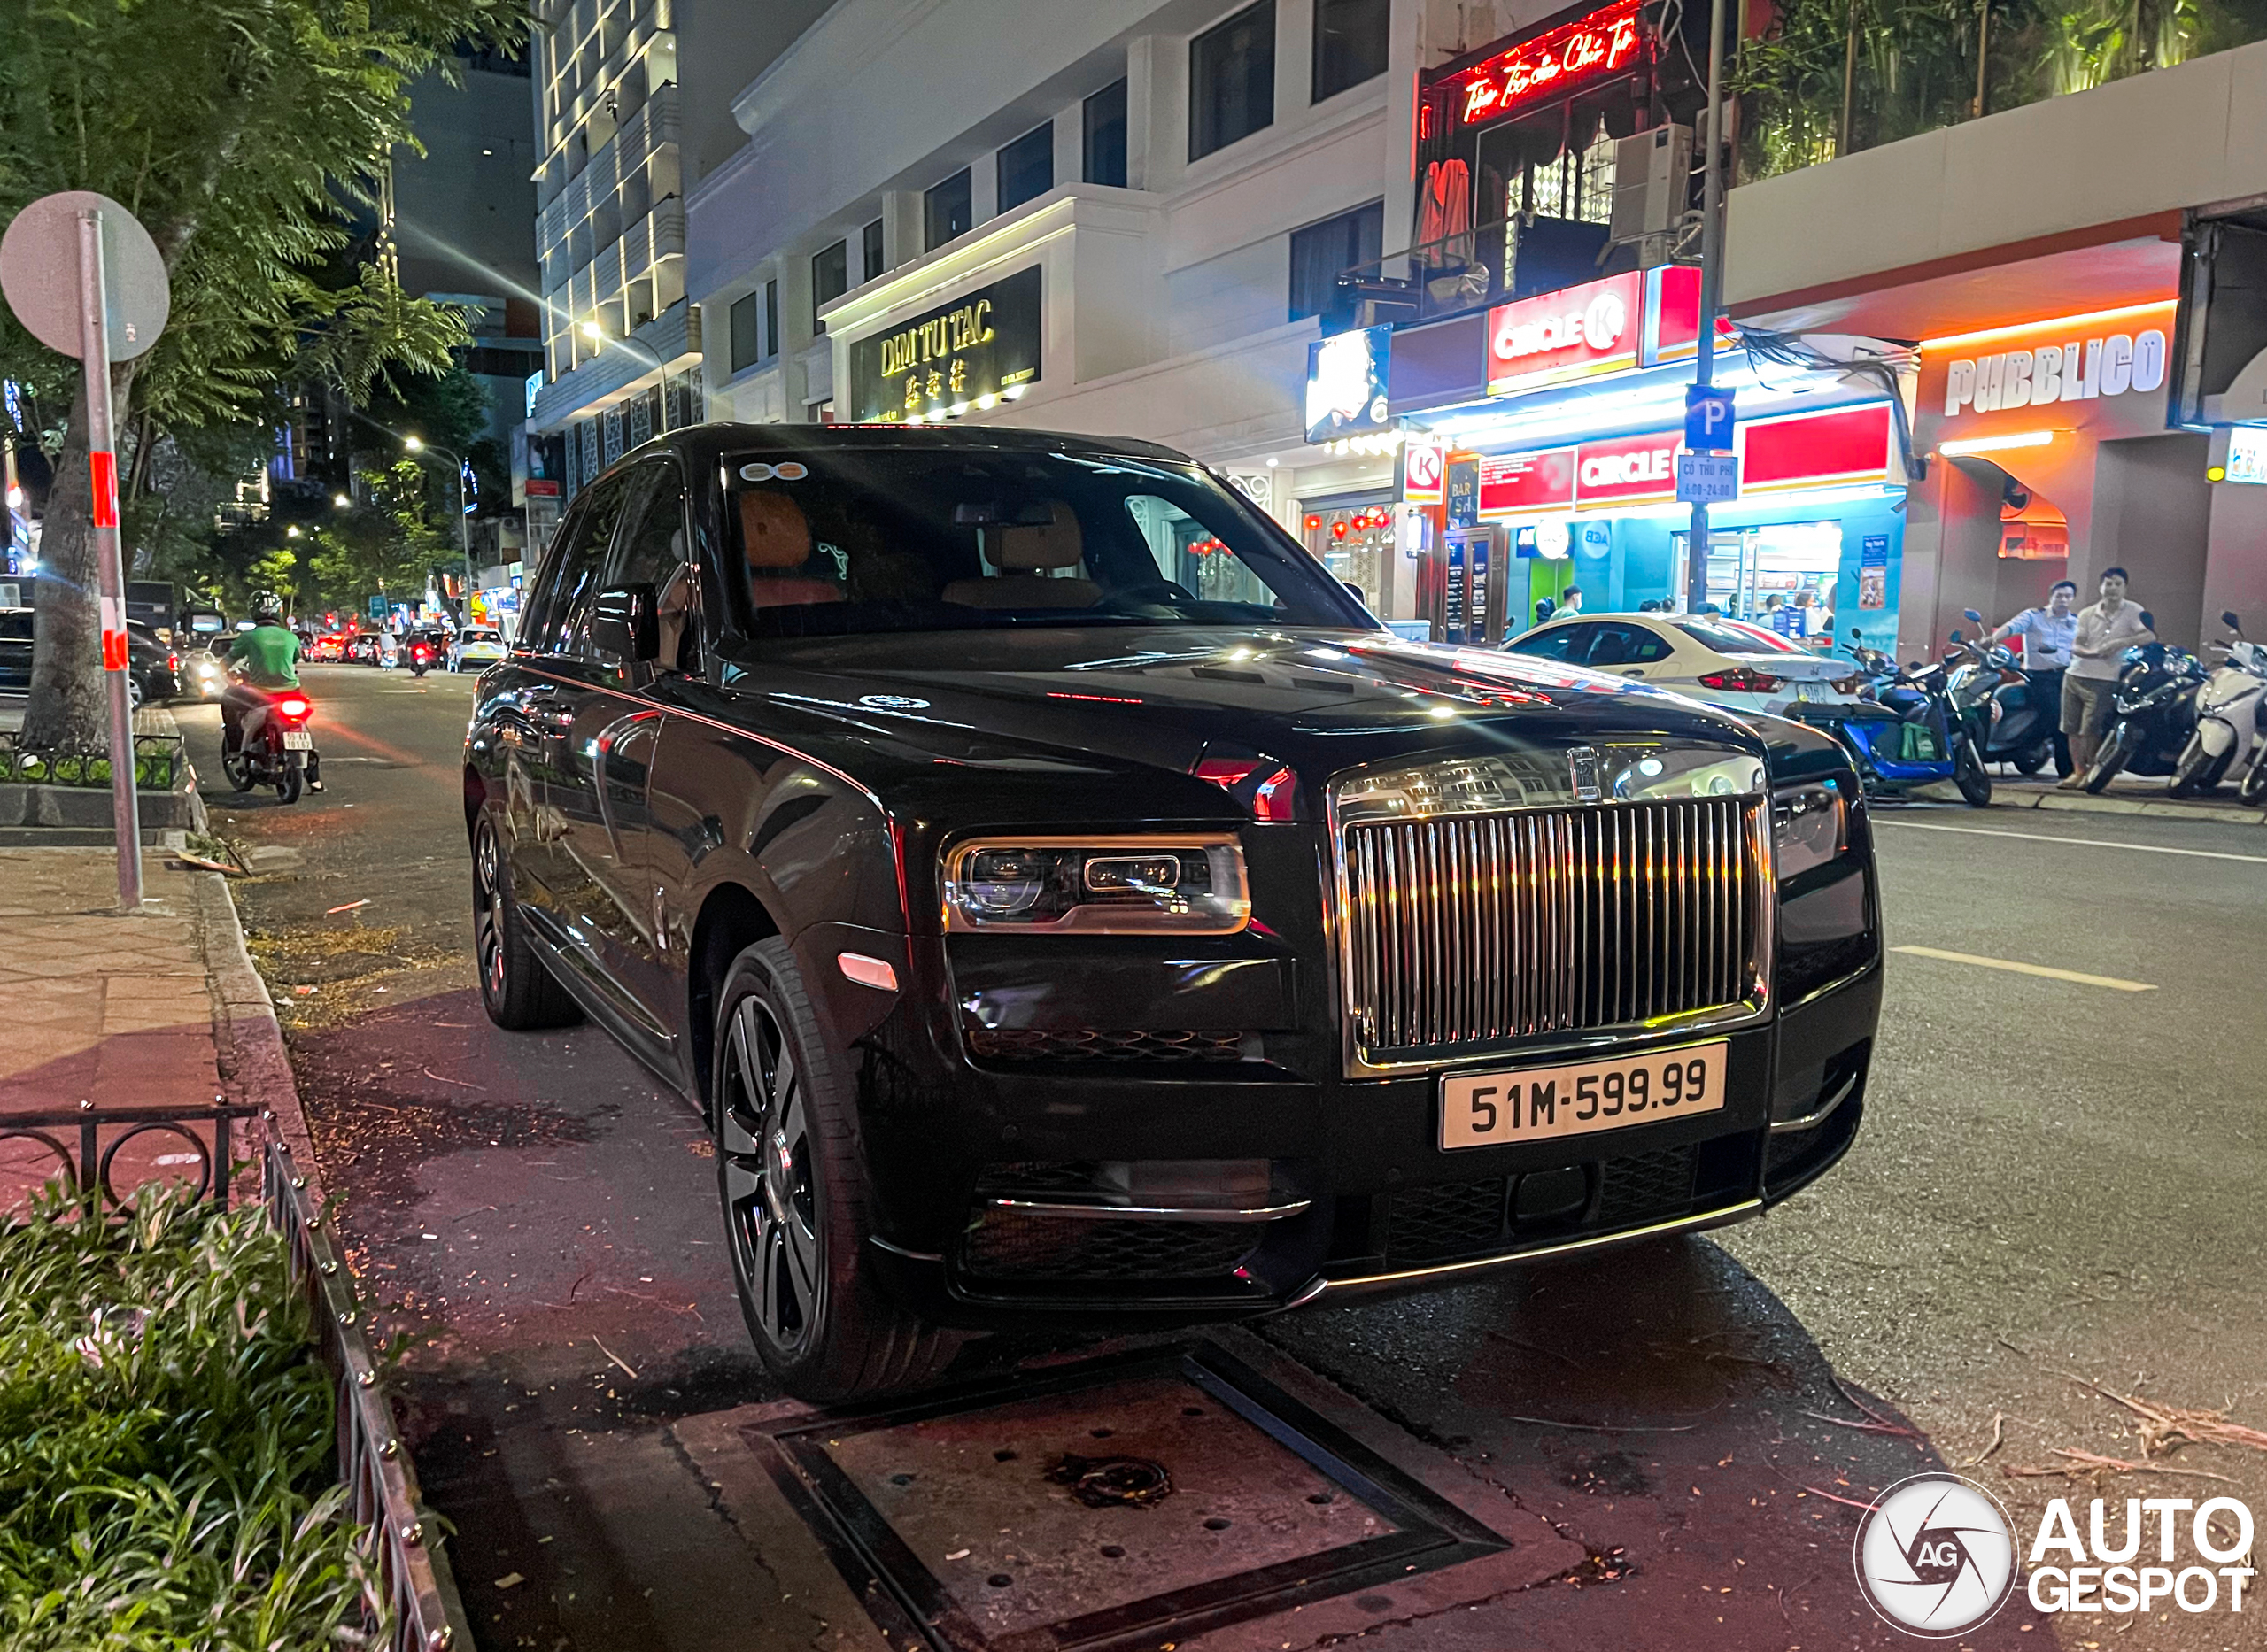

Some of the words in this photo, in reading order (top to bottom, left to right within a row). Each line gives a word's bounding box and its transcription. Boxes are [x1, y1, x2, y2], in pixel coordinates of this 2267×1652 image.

[881, 328, 918, 377] DIM
[918, 316, 948, 362] TU
[949, 298, 994, 351] TAC
[1494, 311, 1584, 359] CIRCLE
[1944, 329, 2166, 417] PUBBLICO
[1705, 400, 1726, 436] P
[1419, 456, 1435, 483] K
[1581, 449, 1671, 487] CIRCLE
[1683, 461, 1695, 475] CÓ
[1699, 464, 1715, 476] THU
[1452, 482, 1471, 498] BAR
[1471, 1059, 1706, 1133] 51M-599.99
